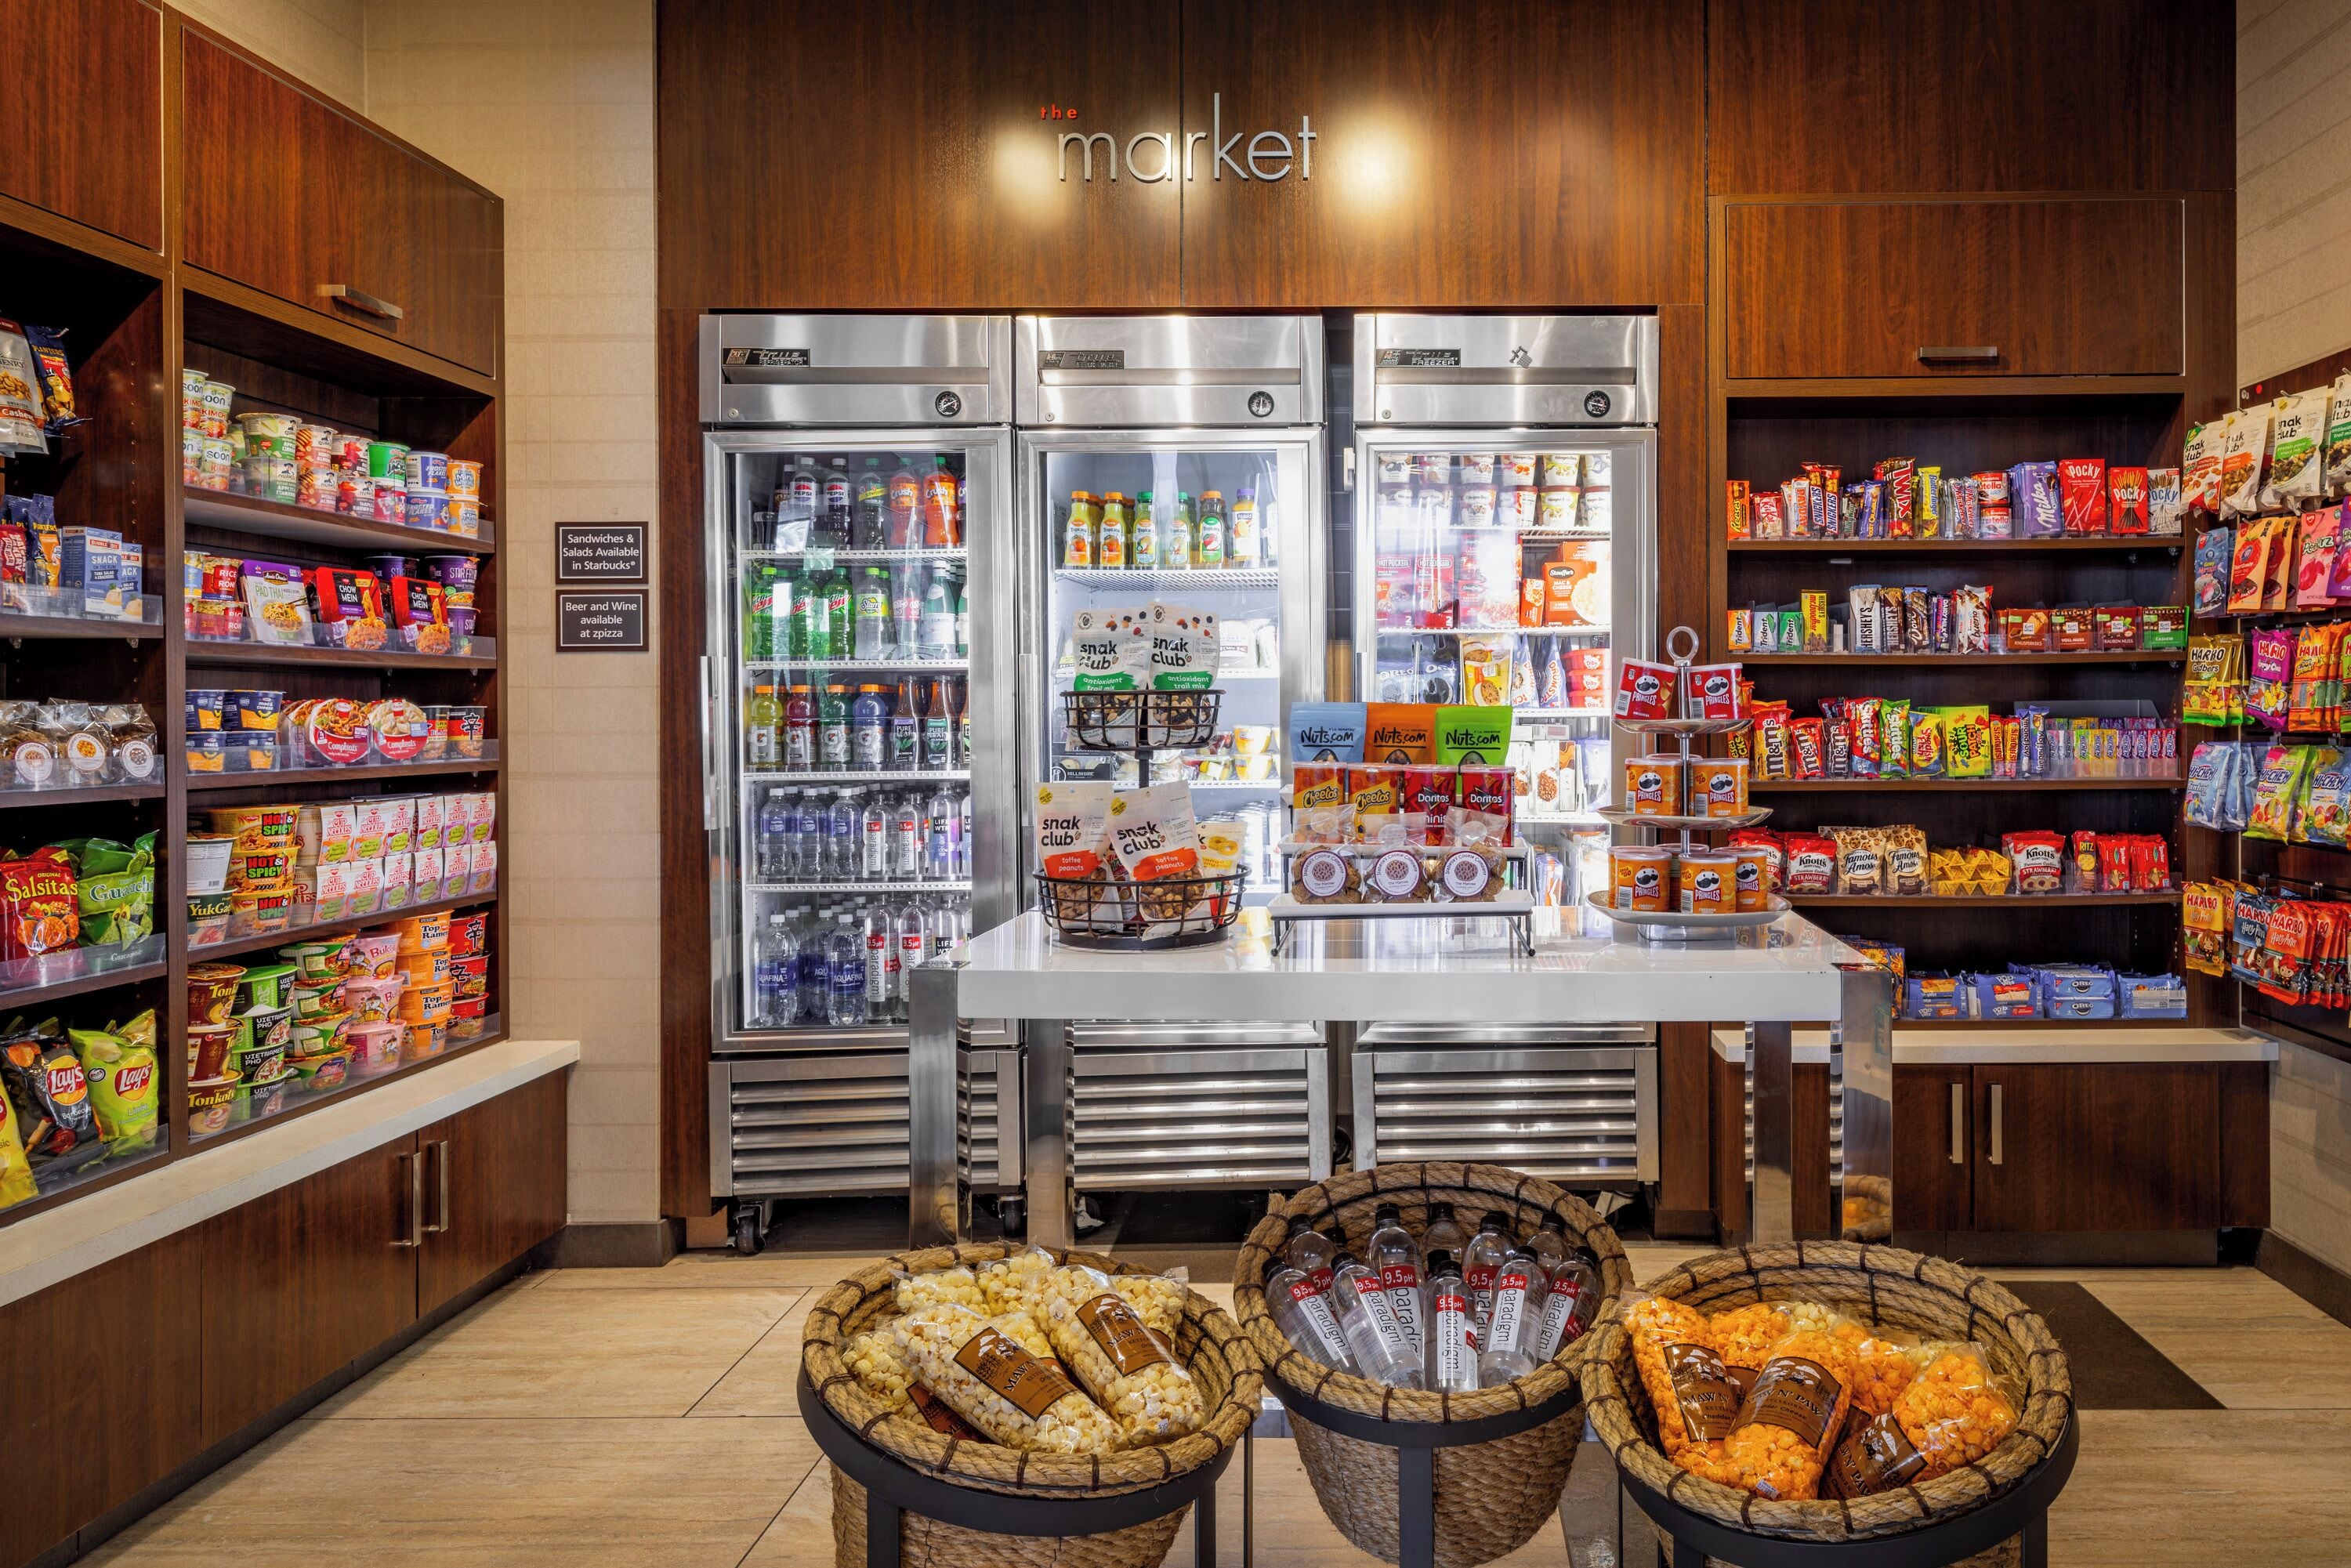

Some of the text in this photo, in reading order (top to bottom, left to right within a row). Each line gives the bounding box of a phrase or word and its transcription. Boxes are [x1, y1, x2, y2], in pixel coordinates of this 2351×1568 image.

[1040, 103, 1078, 120] the
[1058, 92, 1317, 183] market
[31, 346, 64, 356] PLANTERS
[206, 449, 230, 461] soon
[890, 488, 914, 499] Crush
[925, 487, 947, 499] Crush
[1893, 461, 1913, 518] TWIX
[1929, 474, 1939, 516] Butterfinger
[1810, 486, 1825, 526] SNICKERS
[2032, 482, 2056, 527] Milka
[1825, 493, 1838, 533] SNICKERS
[567, 534, 634, 543] Sandwiches &
[563, 547, 639, 556] Salads Available
[92, 555, 118, 564] SNACK
[572, 561, 581, 570] in
[255, 585, 284, 599] PAD THAI
[342, 594, 358, 603] MEIN
[411, 592, 427, 601] CHOW
[413, 599, 428, 610] MEIN
[590, 602, 608, 610] and
[611, 602, 637, 610] Wine
[859, 598, 883, 611] Starry
[580, 615, 622, 625] available
[1860, 607, 1873, 647] HERSHEY'S
[1887, 606, 1898, 646] HERSHEY'S
[1971, 611, 1981, 638] bueno
[580, 628, 623, 639] at zpizza
[1908, 611, 1922, 645] Dove
[1080, 640, 1117, 655] snak
[1153, 636, 1189, 653] snak
[1151, 650, 1186, 667] club
[1083, 675, 1123, 685] antioxidant
[1168, 675, 1209, 683] antioxidant
[1632, 693, 1657, 705] PRINGLES
[1705, 693, 1730, 705] PRINGLES
[1301, 726, 1353, 744] Nuts.com
[1859, 702, 1874, 754] Skittles
[1374, 727, 1426, 744] Nuts.com
[1446, 730, 1501, 747] Nuts.com
[1887, 714, 1902, 759] Skittles
[1958, 725, 1980, 758] SOUR PATCH
[387, 739, 417, 750] Compleats
[1763, 719, 1784, 775] m&m's
[1831, 726, 1847, 773] m&m's
[1992, 726, 2004, 761] Starburst
[2006, 726, 2018, 762] Starburst
[1795, 728, 1819, 774] m&m's
[2189, 766, 2218, 780] HI-CHEW
[2259, 769, 2294, 784] HI-CHEW
[2313, 774, 2348, 791] HI-CHEW
[1302, 786, 1339, 809] Cheetos
[1355, 788, 1391, 814] Cheetos
[1418, 792, 1450, 804] Doritos
[1470, 793, 1502, 804] Doritos
[1637, 791, 1661, 802] PRINGLES
[1709, 791, 1734, 803] PRINGLES
[263, 824, 292, 836] SPICY
[1042, 816, 1081, 831] snak
[1041, 831, 1074, 846] club
[1117, 821, 1160, 842] snak
[1122, 837, 1161, 855] club
[2080, 842, 2094, 851] RITZ
[1156, 855, 1179, 864] toffee
[1840, 852, 1878, 867] Famous
[1888, 849, 1920, 866] Famous
[2026, 847, 2056, 860] Knott's
[248, 856, 275, 867] HOT
[1059, 864, 1084, 873] peanuts
[1155, 862, 1185, 873] peanuts
[1799, 856, 1827, 868] Knott's
[1844, 862, 1875, 875] Amos
[1892, 860, 1918, 874] Amos
[248, 866, 282, 878] SPICY
[5, 877, 78, 903] Salsitas
[1635, 886, 1659, 898] PRINGLES
[1736, 880, 1759, 891] PRINGLES
[1694, 889, 1720, 902] PRINGLES
[2186, 894, 2218, 910] HARIBO
[259, 909, 287, 920] SPICY
[421, 925, 440, 933] Top
[2272, 912, 2304, 934] HARIBO
[833, 974, 864, 983] AQUAFINA
[869, 950, 879, 996] paradigm
[423, 999, 451, 1011] Ramen
[256, 1021, 273, 1030] PHO
[432, 1027, 445, 1037] Top
[51, 1065, 84, 1094] Lay's
[119, 1062, 153, 1092] Lay's
[1303, 1296, 1346, 1349] paradigm
[1366, 1291, 1401, 1343] paradigm
[1495, 1289, 1516, 1342] paradigm
[1539, 1294, 1567, 1350] paradigm
[1107, 1329, 1135, 1349] MAW
[1442, 1311, 1459, 1370] paradigm
[1004, 1363, 1029, 1392] MAW
[1684, 1392, 1716, 1405] MAW
[1780, 1407, 1807, 1420] Cheese
